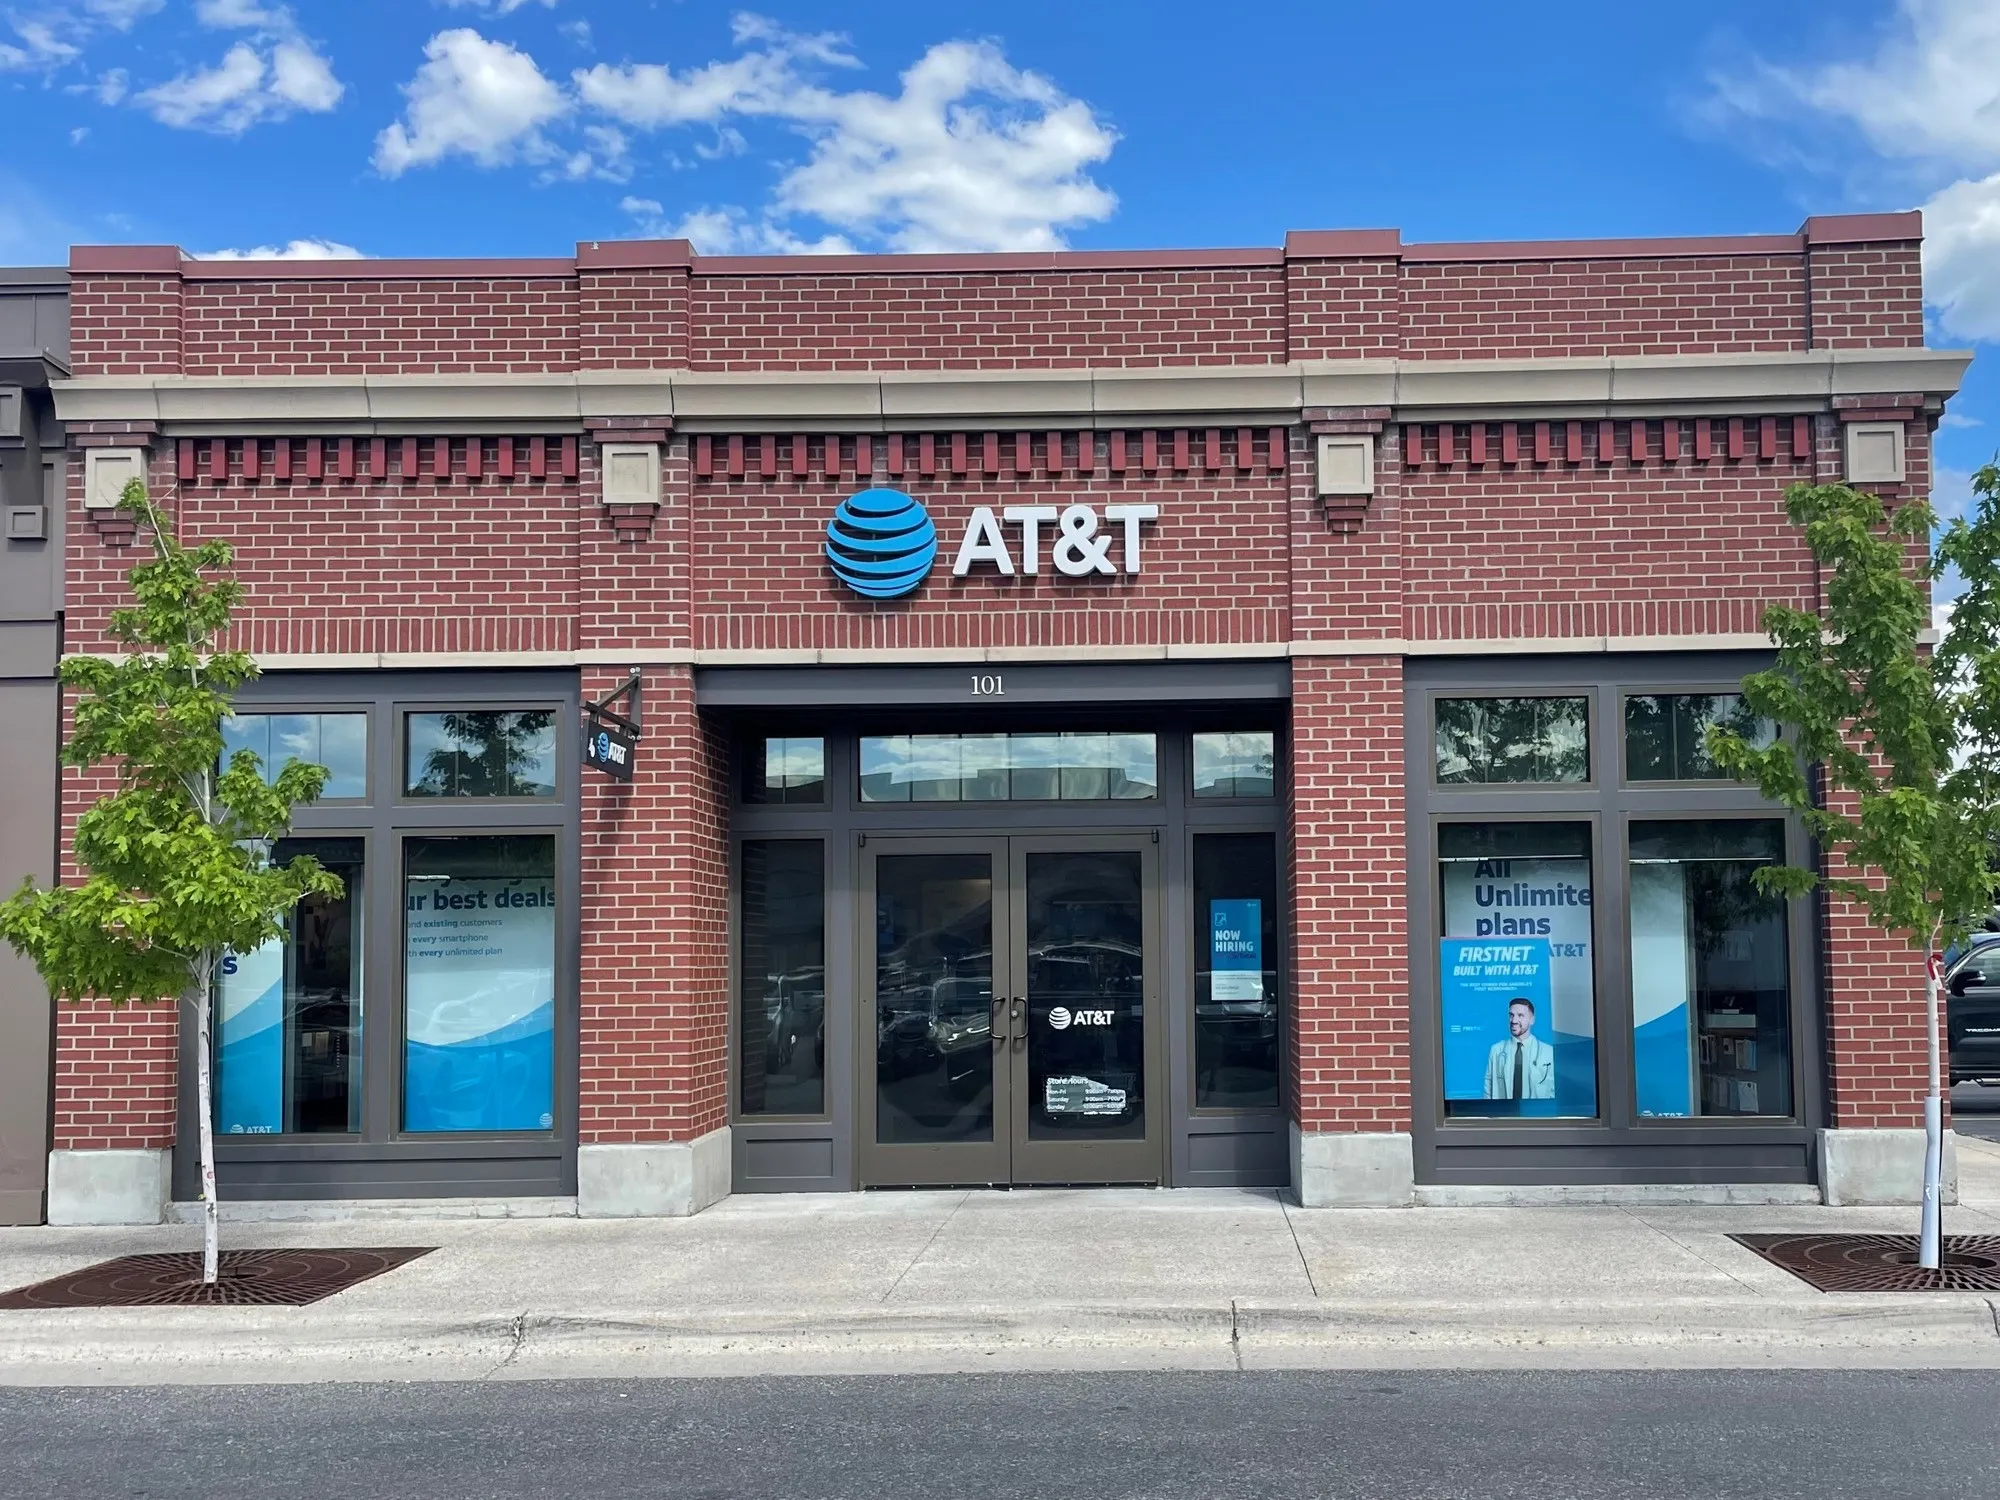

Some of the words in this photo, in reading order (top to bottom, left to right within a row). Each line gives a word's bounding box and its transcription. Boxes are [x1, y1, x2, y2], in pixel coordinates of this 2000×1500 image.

[952, 504, 1159, 577] AT&T
[971, 675, 1005, 695] 101
[1474, 860, 1511, 878] All
[433, 888, 488, 910] best
[424, 919, 458, 928] existing
[460, 918, 502, 926] customers
[1476, 912, 1551, 936] plans
[412, 936, 436, 944] every
[439, 933, 488, 943] smartphone
[1215, 930, 1240, 940] NOW
[445, 948, 483, 956] unlimited
[485, 947, 502, 956] plan
[1215, 941, 1254, 952] HIRING
[1459, 946, 1532, 962] FIRSTNET
[1453, 965, 1482, 976] BUILT
[1484, 964, 1511, 975] WITH
[1512, 963, 1539, 975] AT&T
[1073, 1010, 1115, 1025] AT&T
[246, 1125, 272, 1133] AT&T
